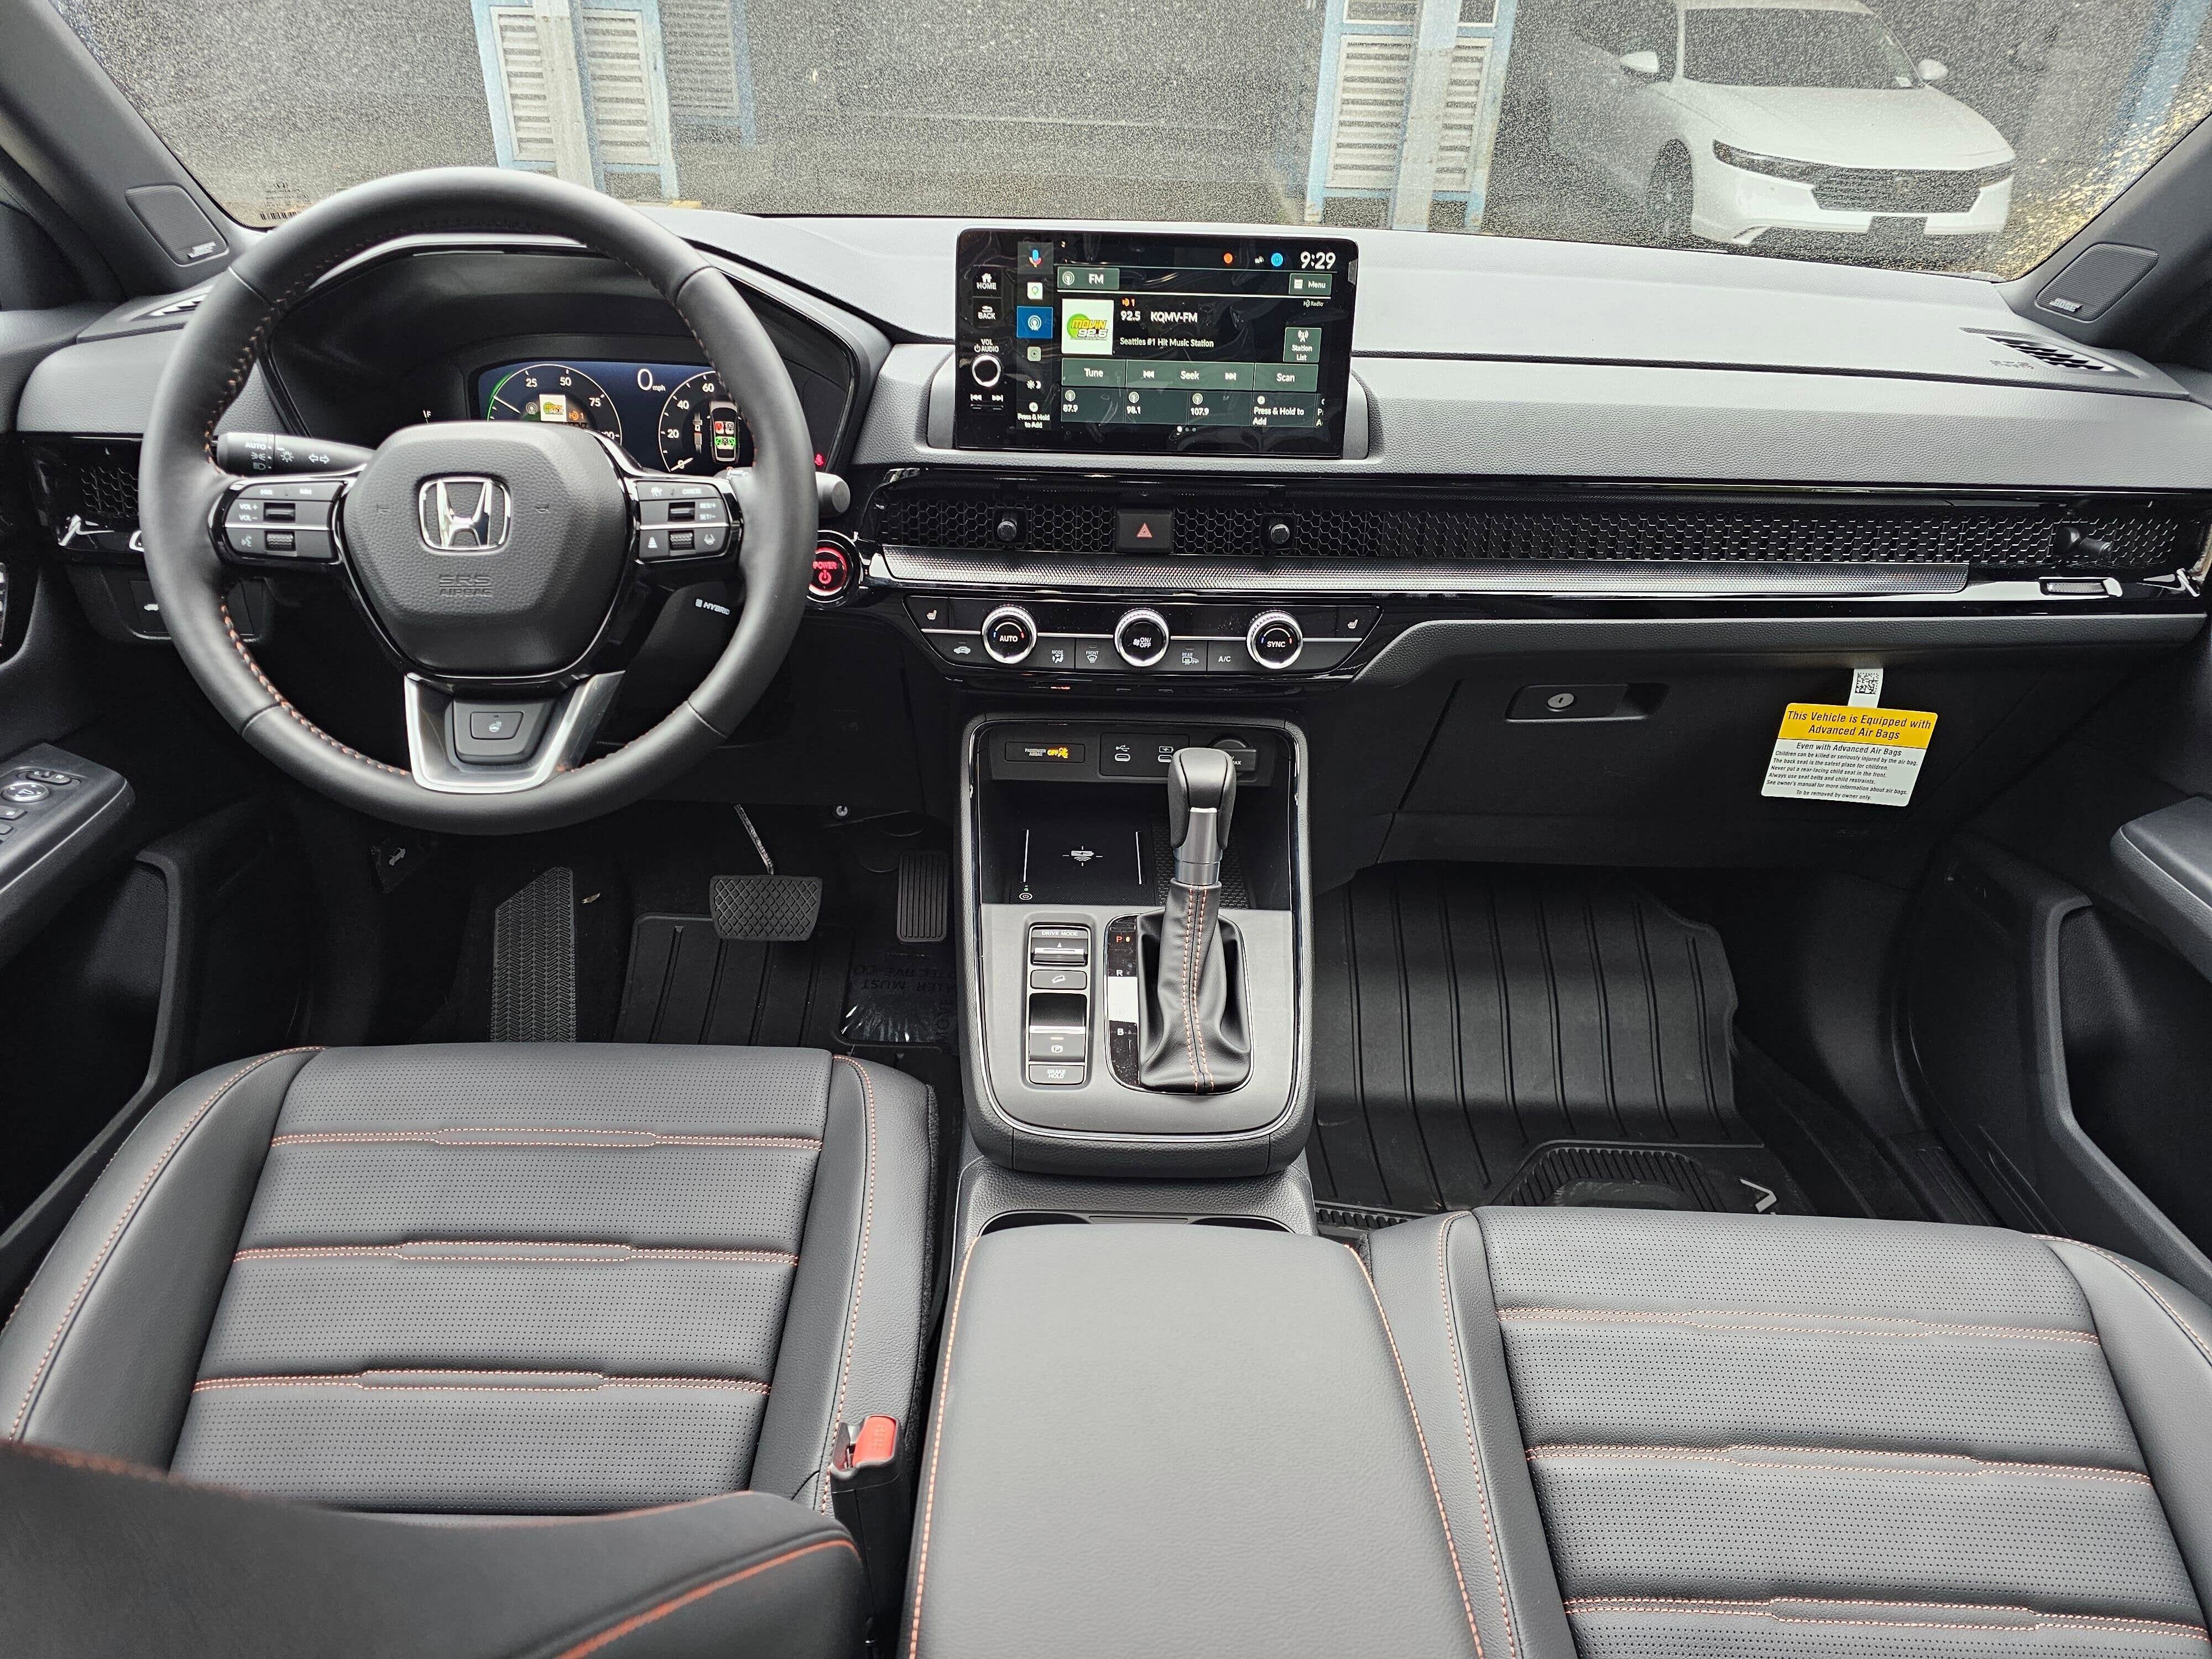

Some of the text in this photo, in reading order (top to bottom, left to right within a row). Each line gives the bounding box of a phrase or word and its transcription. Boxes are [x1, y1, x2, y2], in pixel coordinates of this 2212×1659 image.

[1300, 252, 1336, 269] 9:29
[1089, 274, 1104, 285] FM
[977, 282, 997, 290] HOME
[1131, 299, 1135, 307] 1
[978, 312, 995, 320] BACK
[1120, 310, 1198, 323] 92.5 KQMV-FM
[1158, 338, 1168, 347] Hit
[1169, 338, 1190, 347] Music
[1190, 338, 1214, 348] Station
[1084, 368, 1104, 377] Tune
[1181, 371, 1199, 380] Seek
[1276, 373, 1296, 382] Scan
[526, 378, 538, 388] 25
[560, 377, 571, 387] 50
[637, 368, 653, 391] 0
[702, 383, 714, 393] 60
[589, 398, 601, 407] 75
[677, 400, 690, 410] 40
[1062, 404, 1078, 413] 87.9
[1126, 406, 1141, 414] 98.1
[1190, 407, 1209, 416] 107.9
[1254, 406, 1271, 415] Press
[1253, 418, 1267, 426] Add
[667, 429, 679, 439] 20
[813, 561, 837, 570] POWER
[703, 602, 730, 615] HYBRID
[1788, 711, 1931, 729] This Vehicle is Equipped with
[1808, 725, 1900, 740] Advanced Air Bags
[1833, 744, 1869, 753] Advanced
[1883, 748, 1902, 757] Bags
